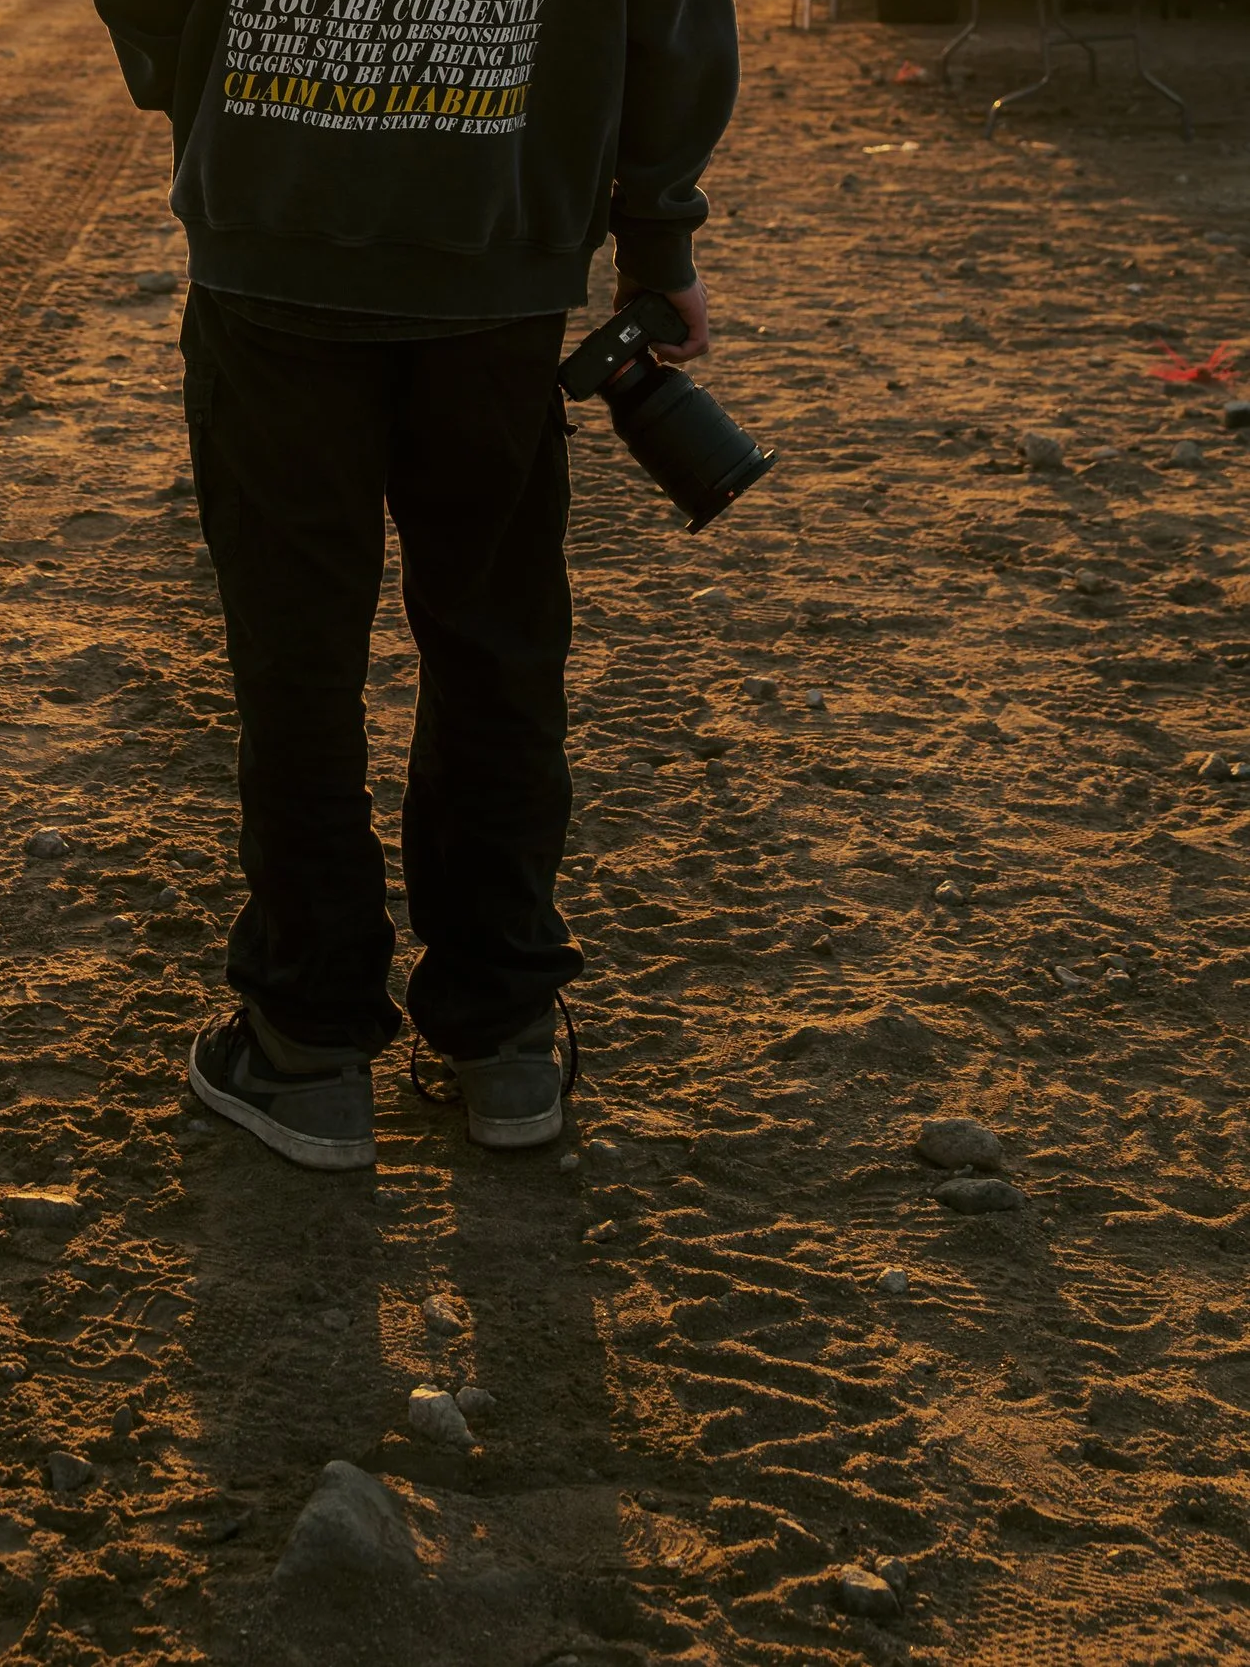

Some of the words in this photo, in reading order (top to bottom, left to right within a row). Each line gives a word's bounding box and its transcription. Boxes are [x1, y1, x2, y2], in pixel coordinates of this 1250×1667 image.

[226, 27, 253, 50] TO
[260, 33, 309, 57] THE
[312, 38, 386, 64] STATE
[392, 42, 425, 63] OF
[429, 41, 506, 67] BEING
[509, 40, 540, 66] YOU
[293, 17, 322, 36] WE
[326, 20, 372, 40] TAKE
[376, 24, 402, 40] NO
[406, 22, 543, 44] RESPONSIBILITY
[226, 51, 318, 79] SUGGEST
[322, 61, 349, 83] TO
[353, 63, 384, 85] BE
[388, 63, 413, 84] IN
[418, 64, 465, 86] AND
[469, 62, 535, 88] HEREBY
[224, 71, 322, 108] CLAIM
[324, 83, 376, 115] NO
[383, 82, 533, 118] LIABILITY
[223, 99, 255, 117] FOR
[260, 103, 300, 122] YOUR
[302, 110, 378, 132] CURRENT
[380, 114, 431, 131] STATE
[434, 115, 459, 132] OF
